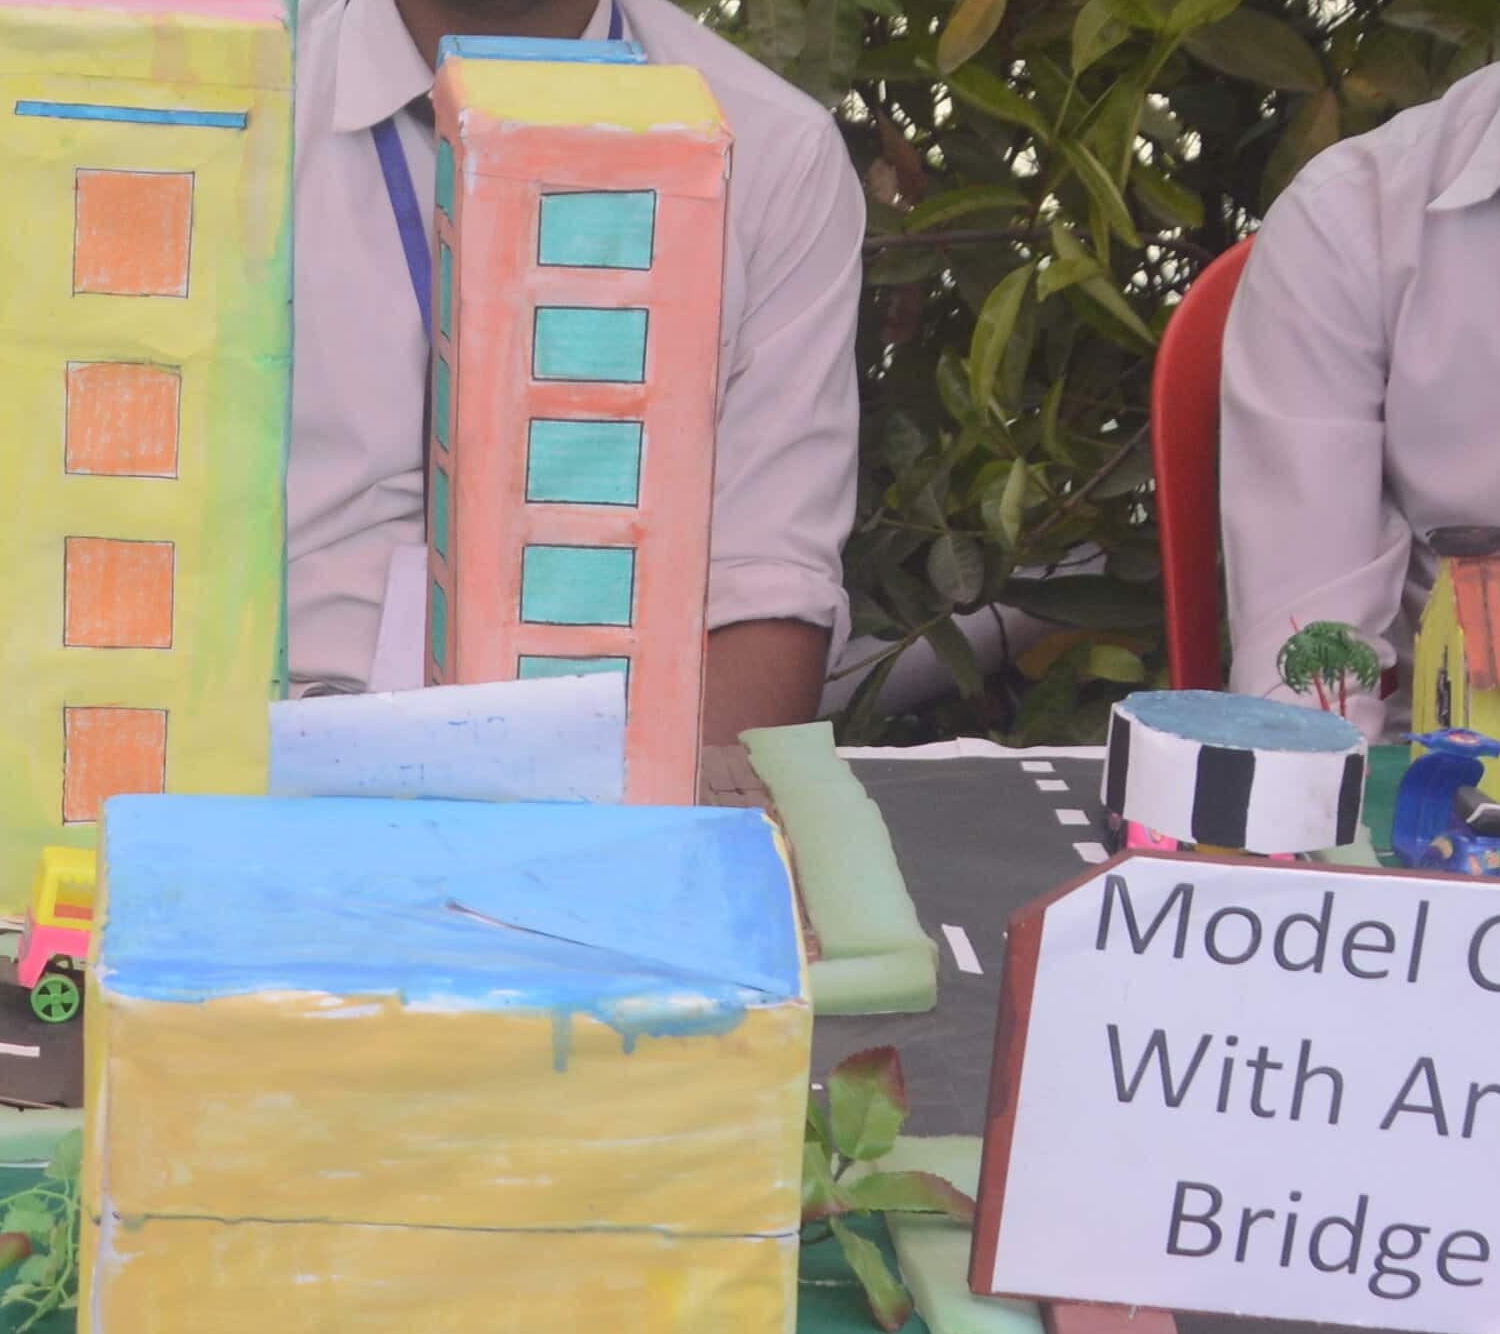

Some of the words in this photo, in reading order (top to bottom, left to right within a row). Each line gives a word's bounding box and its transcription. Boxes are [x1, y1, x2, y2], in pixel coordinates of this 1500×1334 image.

[1094, 873, 1430, 984] Model
[1105, 1023, 1345, 1126] With
[1165, 1180, 1492, 1300] Bridge
